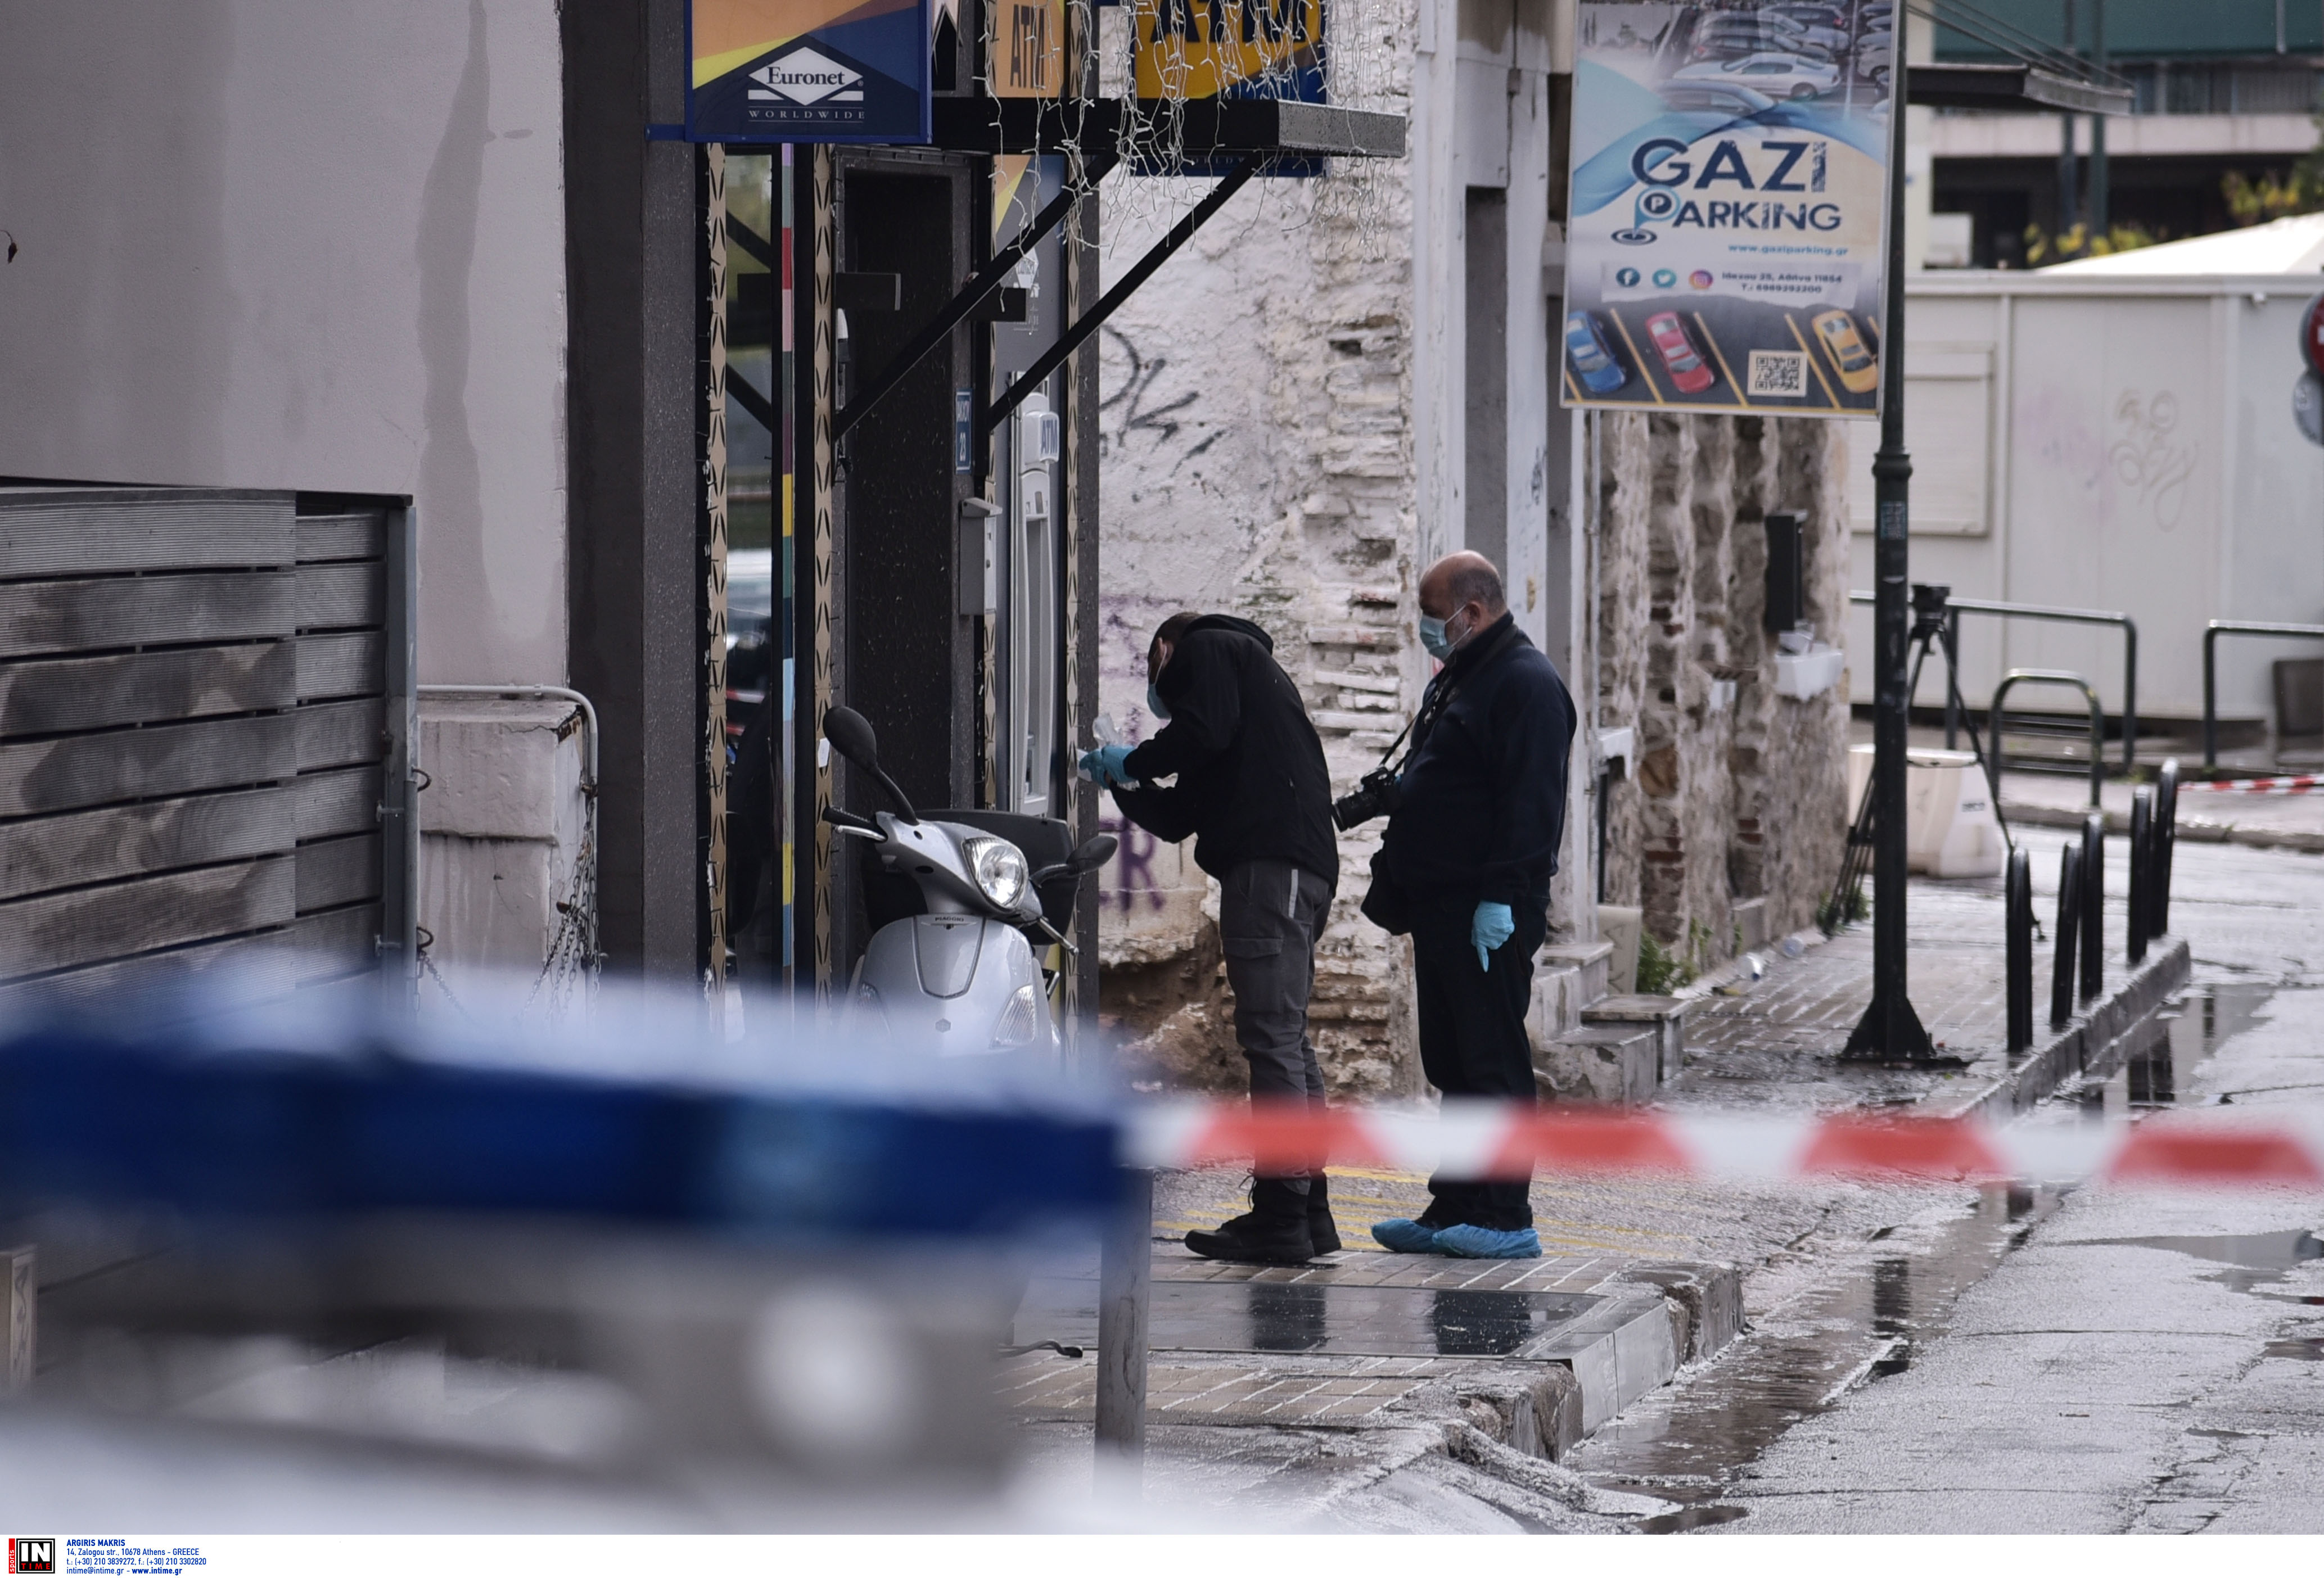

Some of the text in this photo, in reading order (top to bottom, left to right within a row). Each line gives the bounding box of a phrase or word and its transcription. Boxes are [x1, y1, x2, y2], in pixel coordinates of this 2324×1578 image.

[1010, 4, 1045, 89] ATM
[766, 66, 845, 85] Euronet
[749, 110, 865, 119] WORLDWIDE
[1632, 138, 1827, 193] GAZI
[1728, 244, 1848, 256] www.gaziparking.gr
[1040, 419, 1058, 454] ATM
